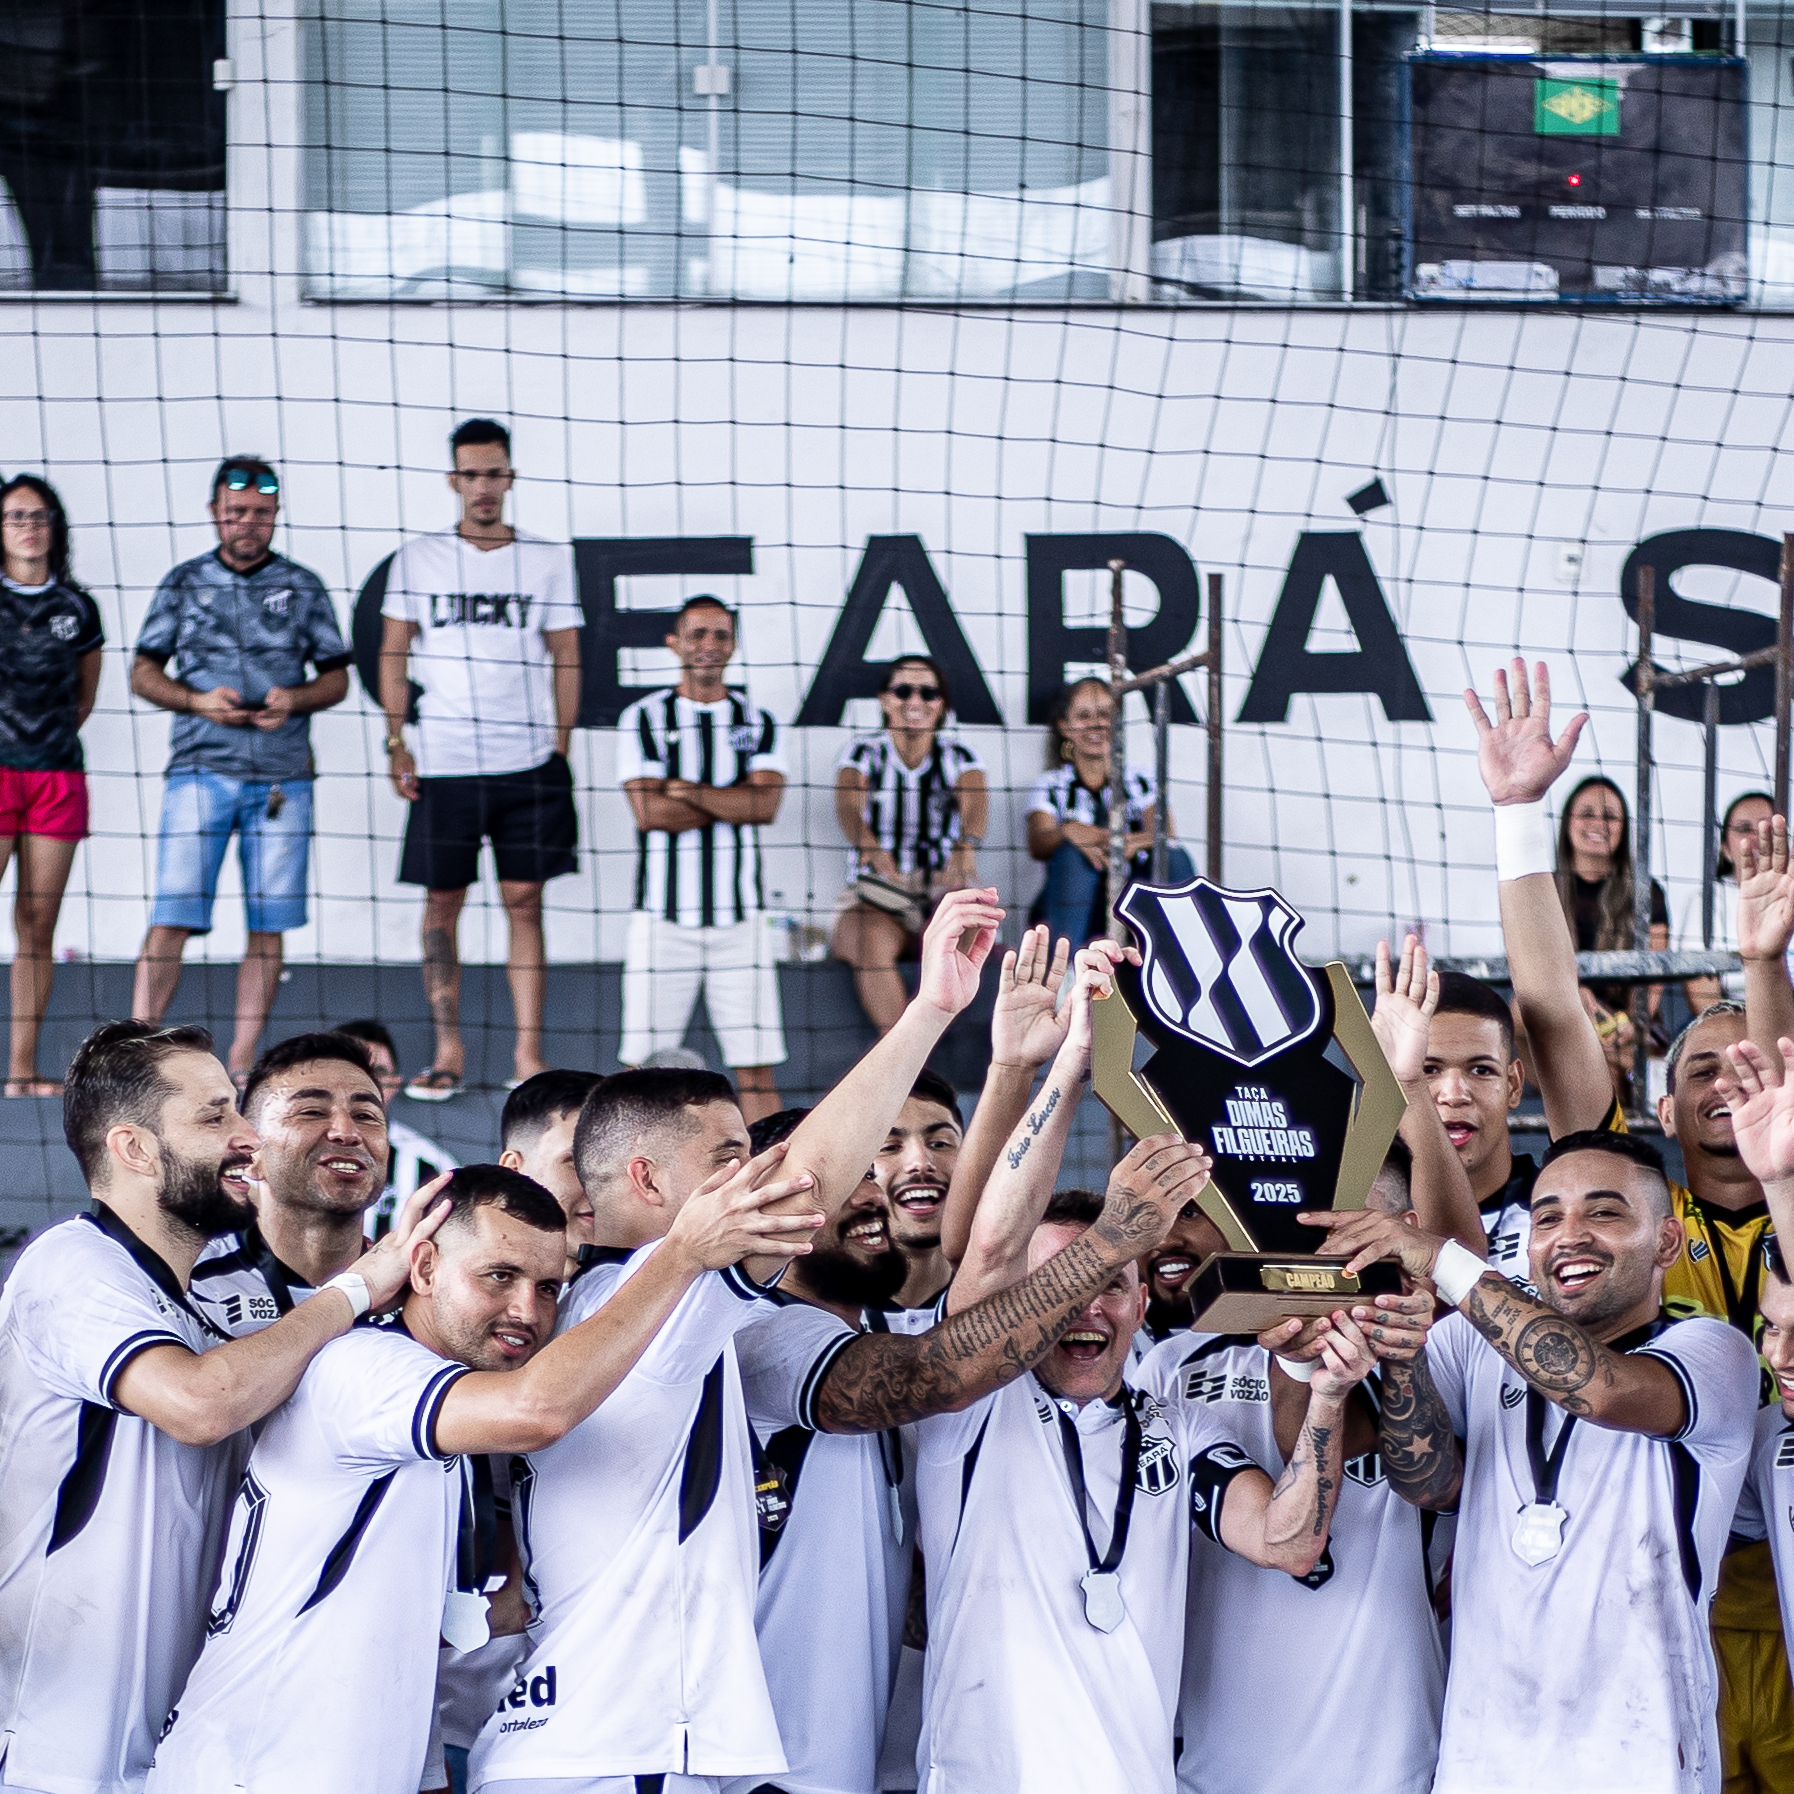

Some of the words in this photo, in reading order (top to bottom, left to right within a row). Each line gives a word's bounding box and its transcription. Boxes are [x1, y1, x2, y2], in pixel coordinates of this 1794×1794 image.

[430, 592, 534, 628] LUCKY
[1235, 1086, 1268, 1101] TAÇA
[1225, 1099, 1288, 1128] DIMAS
[1211, 1126, 1315, 1158] FILGUEIRAS
[1250, 1182, 1302, 1204] 2025
[1286, 1271, 1336, 1289] CAMPEÃO
[1232, 1376, 1266, 1390] SÓCIO
[1229, 1388, 1269, 1402] VOZÃO
[1137, 1443, 1169, 1468] EARÁ
